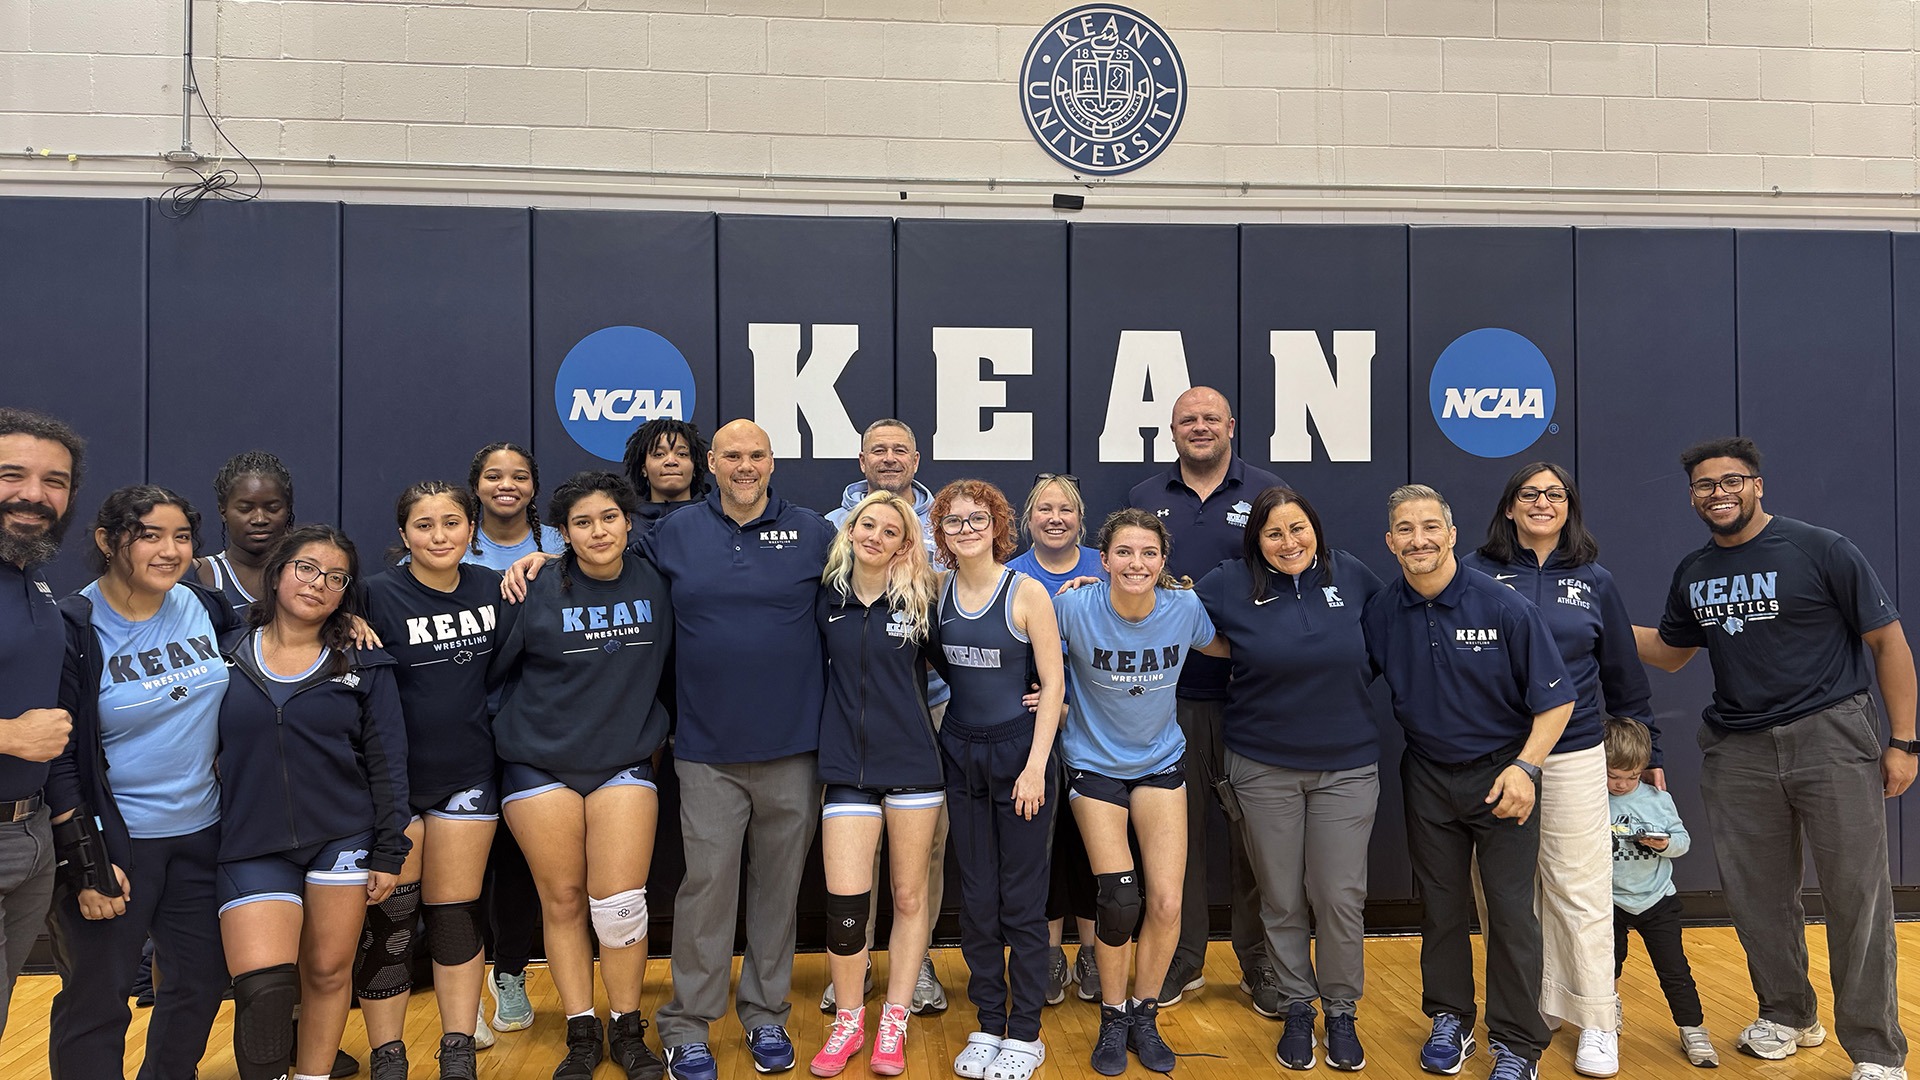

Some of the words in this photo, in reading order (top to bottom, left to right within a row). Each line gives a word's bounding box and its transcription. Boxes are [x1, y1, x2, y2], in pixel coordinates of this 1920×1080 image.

[1055, 15, 1150, 49] KEAN
[1075, 48, 1090, 59] 18
[1115, 49, 1130, 60] 55
[1029, 81, 1176, 165] UNIVERSITY
[568, 388, 683, 421] NCAA
[748, 322, 1377, 462] KEAN
[1441, 388, 1545, 419] NCAA
[760, 530, 798, 541] KEAN
[1558, 578, 1591, 593] KEAN
[1689, 571, 1778, 609] KEAN
[562, 599, 653, 632] KEAN
[1557, 596, 1591, 610] ATHLETICS
[406, 604, 496, 645] KEAN
[584, 626, 640, 641] WRESTLING
[1456, 629, 1498, 641] KEAN
[433, 635, 487, 651] WRESTLING
[941, 643, 1002, 668] KEAN
[108, 634, 219, 684] KEAN
[1091, 644, 1180, 673] KEAN
[141, 665, 208, 690] WRESTLING
[1111, 674, 1164, 683] WRESTLING
